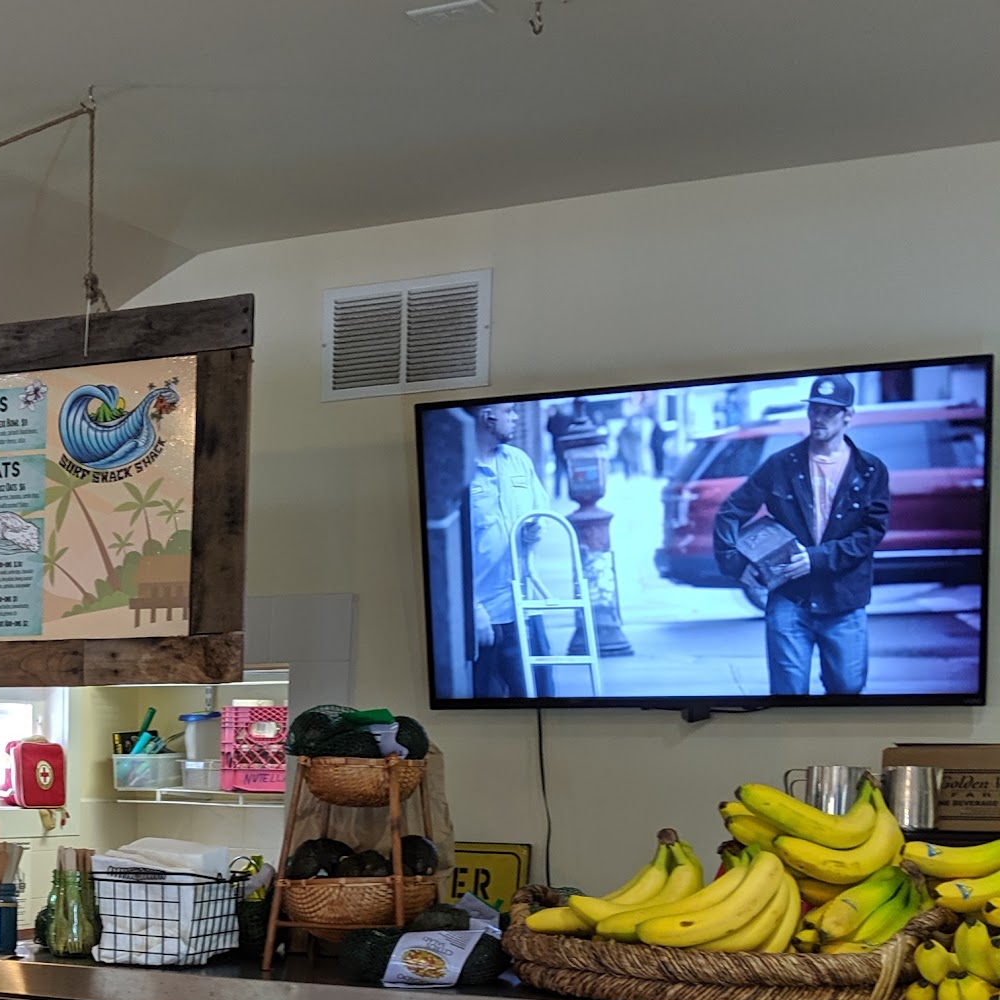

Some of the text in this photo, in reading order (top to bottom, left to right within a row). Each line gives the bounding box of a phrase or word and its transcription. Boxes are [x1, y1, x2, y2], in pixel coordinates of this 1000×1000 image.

[6, 418, 19, 427] BOWL
[58, 453, 90, 480] SURF
[92, 466, 133, 483] SNACK
[244, 773, 285, 785] NUTELL
[451, 867, 491, 900] ER
